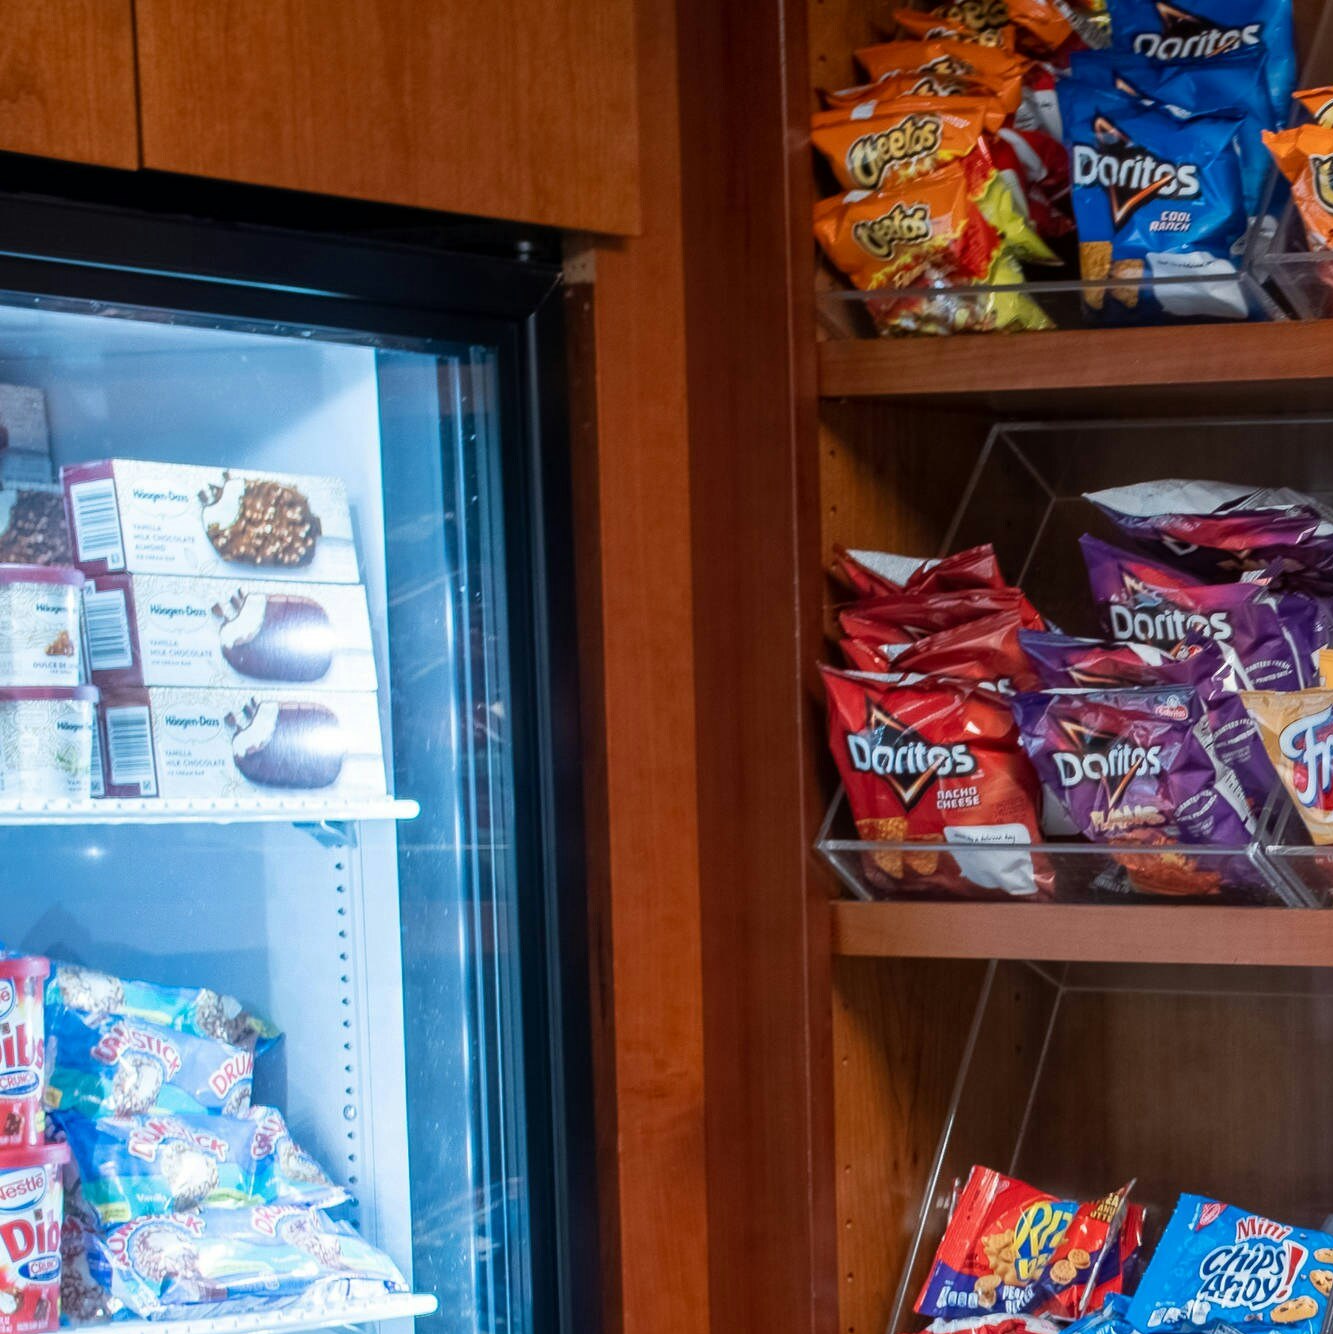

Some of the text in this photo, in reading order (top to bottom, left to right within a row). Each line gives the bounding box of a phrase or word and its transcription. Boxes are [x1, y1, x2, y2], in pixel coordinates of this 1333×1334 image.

[1073, 145, 1200, 197] Doritos
[1149, 220, 1191, 233] RANCH
[1160, 211, 1191, 223] COOL
[848, 734, 977, 776] Doritos
[1054, 744, 1161, 787] Doritos
[937, 787, 978, 800] NACHO
[937, 796, 980, 809] CHEESE
[1236, 1216, 1291, 1243] Mini
[1201, 1243, 1287, 1276] Chips
